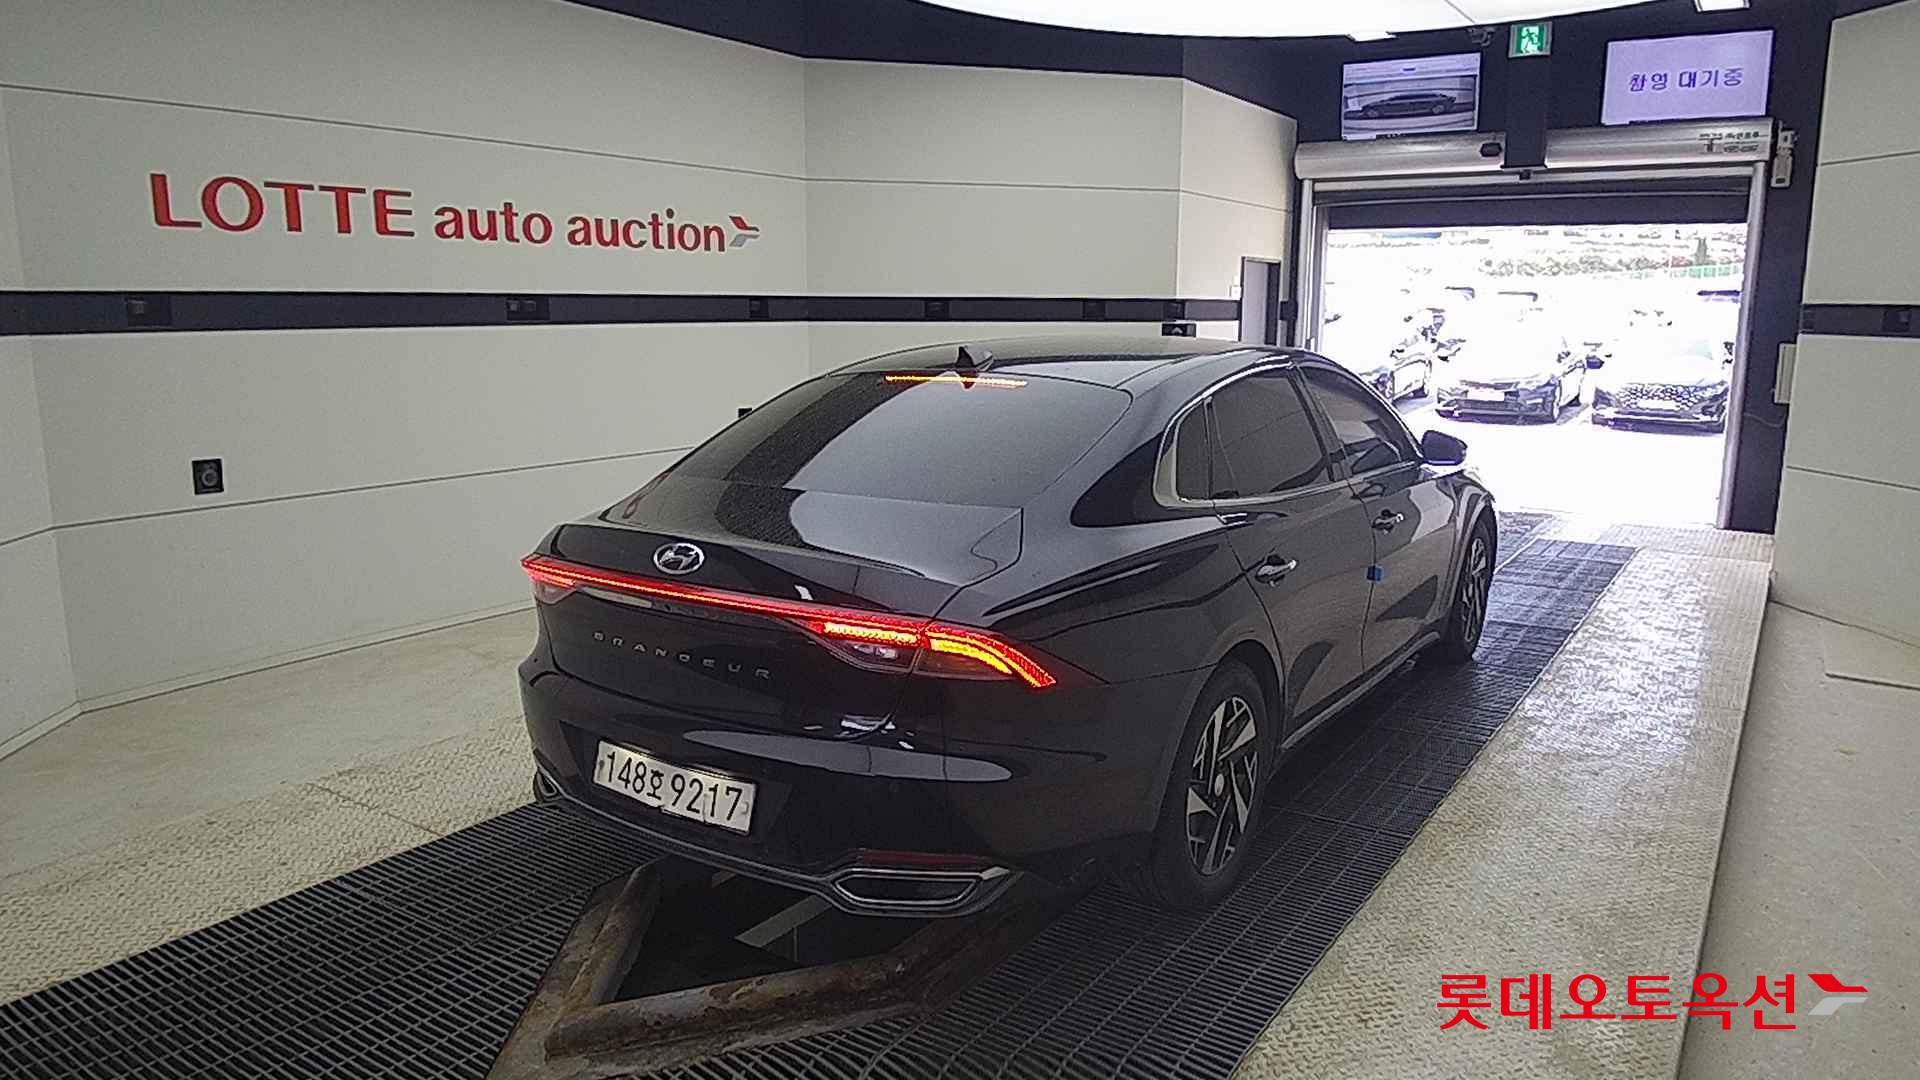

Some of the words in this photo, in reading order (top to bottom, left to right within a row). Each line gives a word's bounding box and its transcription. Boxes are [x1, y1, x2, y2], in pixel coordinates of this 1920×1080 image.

[1678, 67, 1743, 89] 대기중
[149, 172, 415, 238] LOTTE
[434, 201, 554, 246] auto
[566, 207, 727, 253] auction
[593, 631, 771, 680] GRANDEUR
